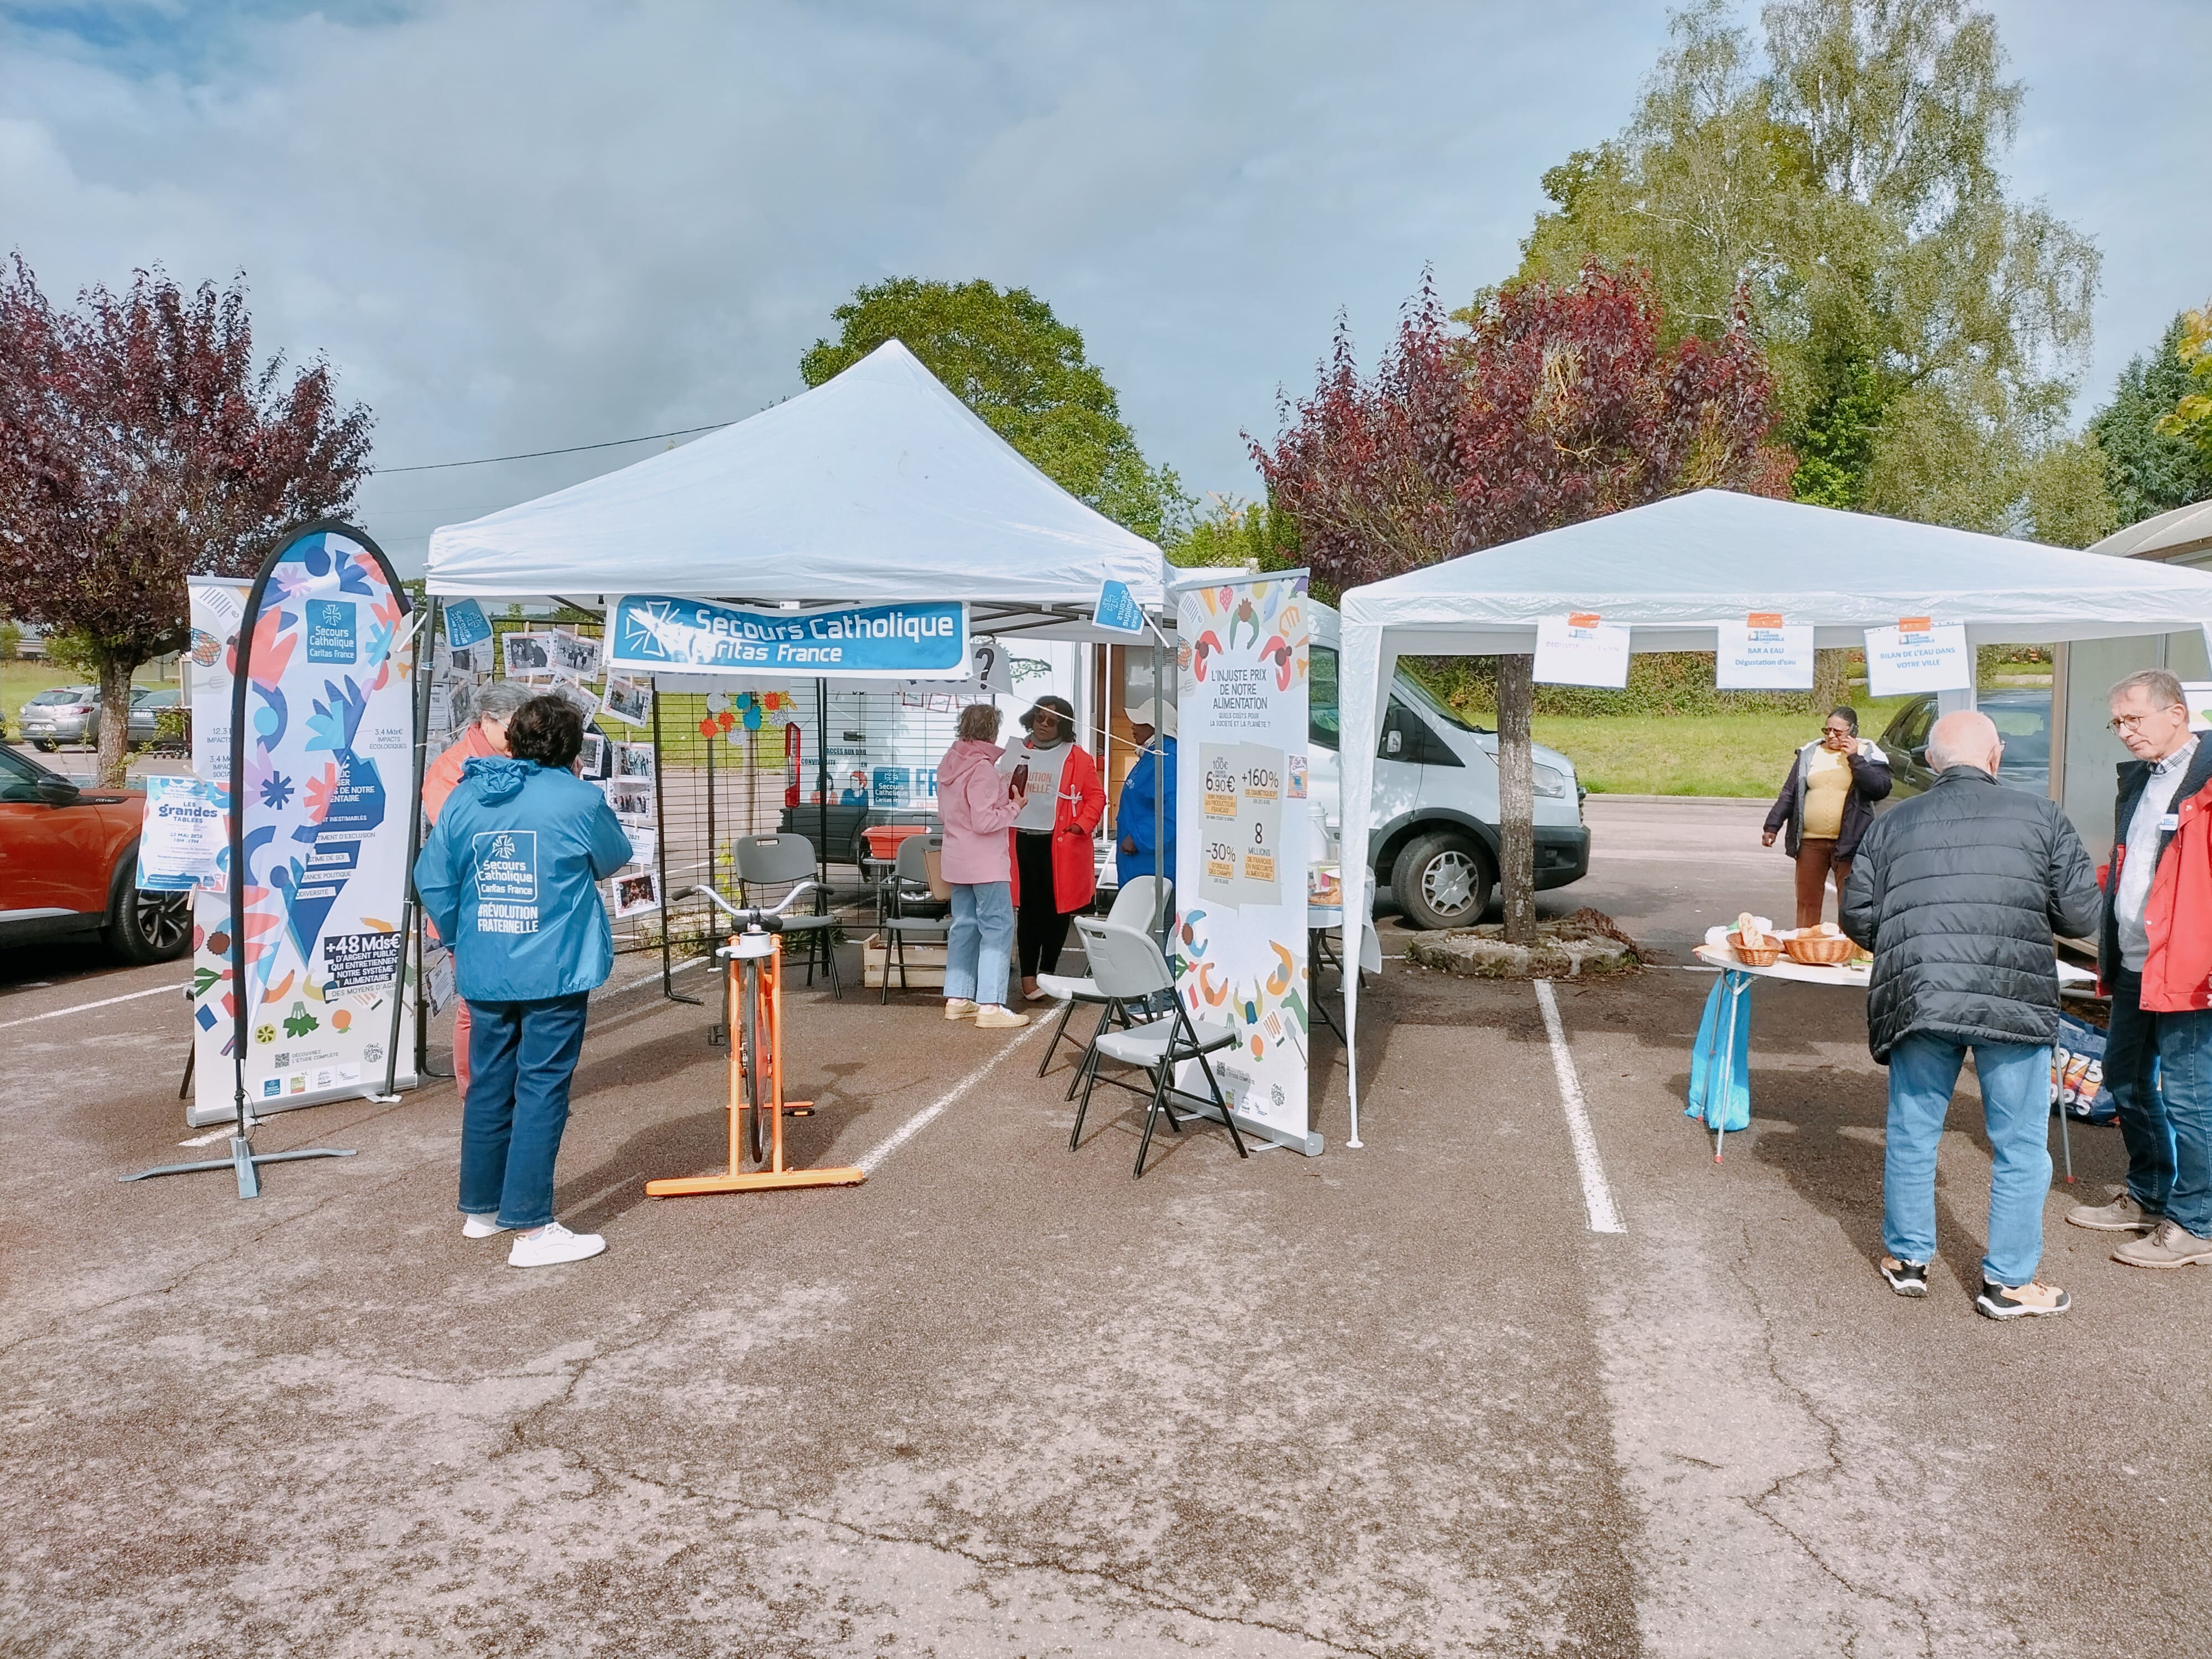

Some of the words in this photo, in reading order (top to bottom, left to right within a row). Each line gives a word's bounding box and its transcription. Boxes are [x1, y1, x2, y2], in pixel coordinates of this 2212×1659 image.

[455, 610, 473, 638] Secours
[696, 609, 804, 640] Secours
[810, 612, 953, 643] Catholique
[315, 625, 349, 637] Secours
[310, 635, 354, 649] Catholique
[310, 649, 332, 658] Caritas
[334, 650, 354, 659] France
[711, 640, 769, 661] ritas
[777, 644, 842, 662] France
[1212, 669, 1248, 681] L'INJUSTE
[1250, 669, 1266, 681] PRIX
[1220, 684, 1229, 695] DE
[1232, 683, 1256, 695] NOTRE
[1213, 697, 1267, 709] ALIMENTATION
[1213, 760, 1228, 770] 100€
[1241, 768, 1279, 787] +160%
[159, 804, 217, 817] grandes
[1255, 822, 1262, 844] 8
[1206, 843, 1236, 862] -30%
[1248, 847, 1271, 857] MILLIONS
[483, 860, 526, 871] Secours
[478, 870, 533, 884] Catholique
[481, 884, 505, 894] Caritas
[507, 885, 533, 895] France
[478, 902, 538, 919] #RÉVOLUTION
[478, 919, 539, 934] FRATERNELLE
[326, 935, 359, 954] +48
[362, 933, 401, 952] Mds€
[336, 952, 372, 962] D'ARGENT
[373, 949, 397, 958] PUBLIC
[331, 963, 344, 972] QUI
[337, 969, 361, 978] NOTRE
[362, 965, 393, 975] SYSTÈME
[343, 974, 389, 986] ALIMENTAIRE
[347, 985, 374, 995] MOYENS
[292, 1050, 321, 1058] DÉCOUVREZ
